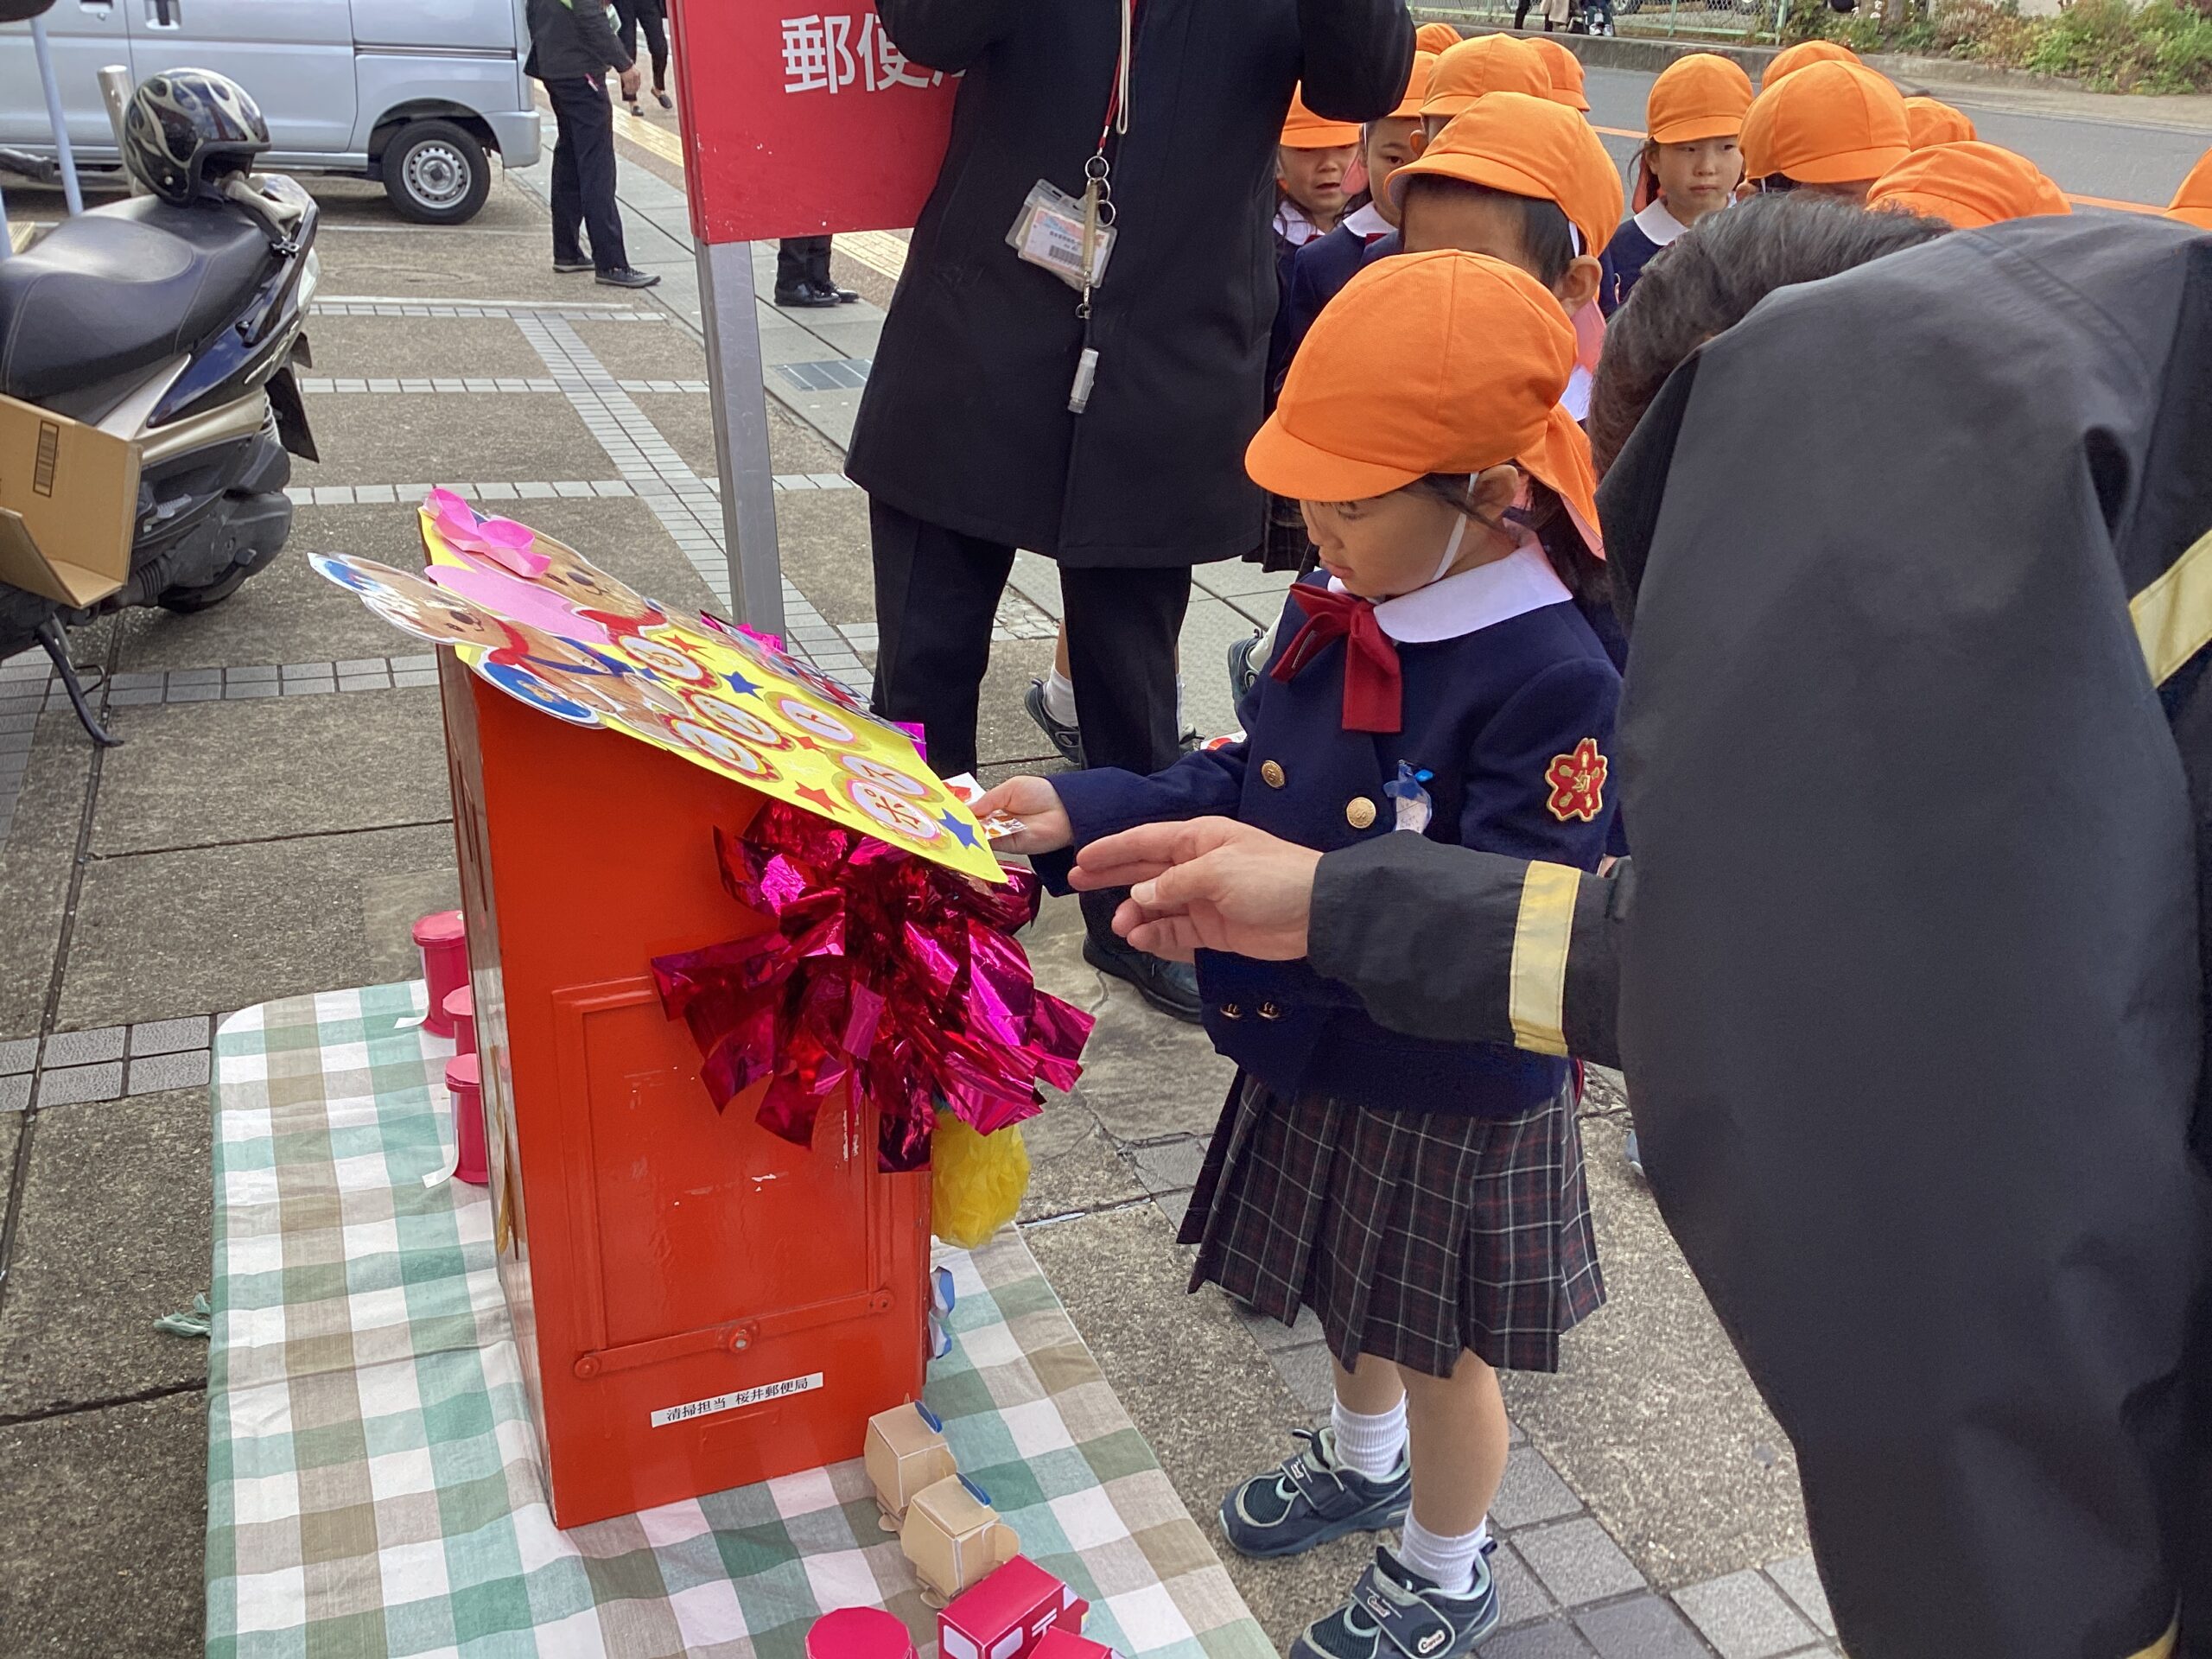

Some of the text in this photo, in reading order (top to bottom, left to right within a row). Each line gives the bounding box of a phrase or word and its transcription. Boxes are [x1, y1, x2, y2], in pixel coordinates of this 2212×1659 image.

[781, 13, 966, 93] 郵便
[666, 1377, 808, 1421] 清掃担当 桜井郵便局
